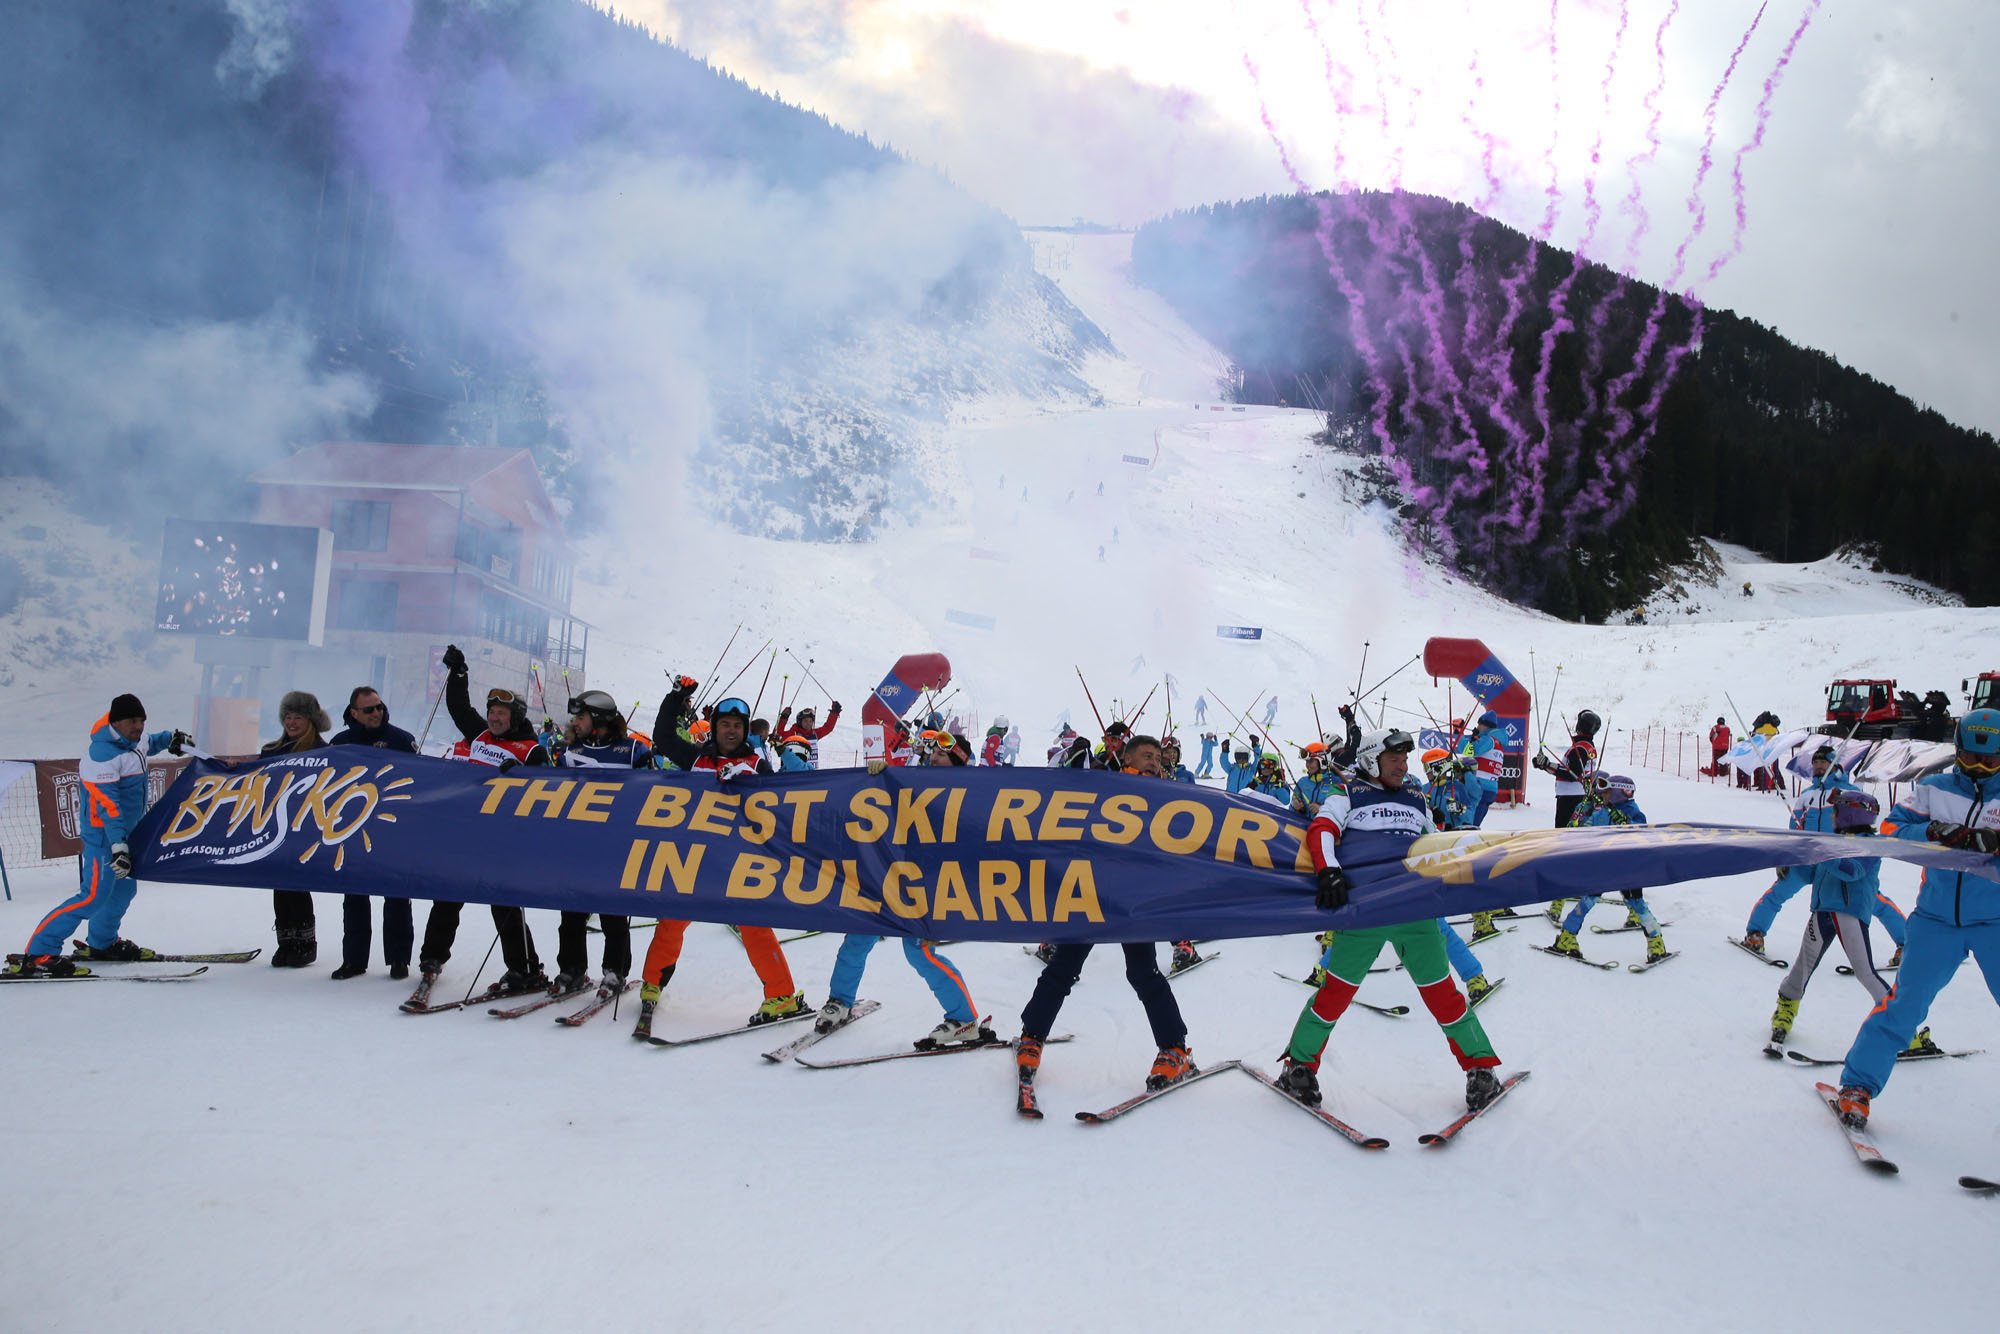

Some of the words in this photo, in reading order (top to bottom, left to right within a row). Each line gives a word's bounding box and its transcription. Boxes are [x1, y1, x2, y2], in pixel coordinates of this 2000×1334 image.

[477, 745, 506, 761] Fibank
[1508, 738, 1524, 746] ank
[160, 765, 379, 865] BANSKO
[480, 777, 624, 823] THE
[636, 785, 828, 845] BEST
[845, 787, 967, 845] SKI
[986, 787, 1316, 874] RESORT
[1371, 807, 1416, 820] Fibank
[155, 853, 176, 863] ALL
[180, 845, 226, 856] SEASONS
[228, 831, 271, 855] RESORT
[620, 839, 707, 894] IN
[725, 853, 1106, 923] BULGARIA
[954, 1021, 976, 1037] ATOMIC
